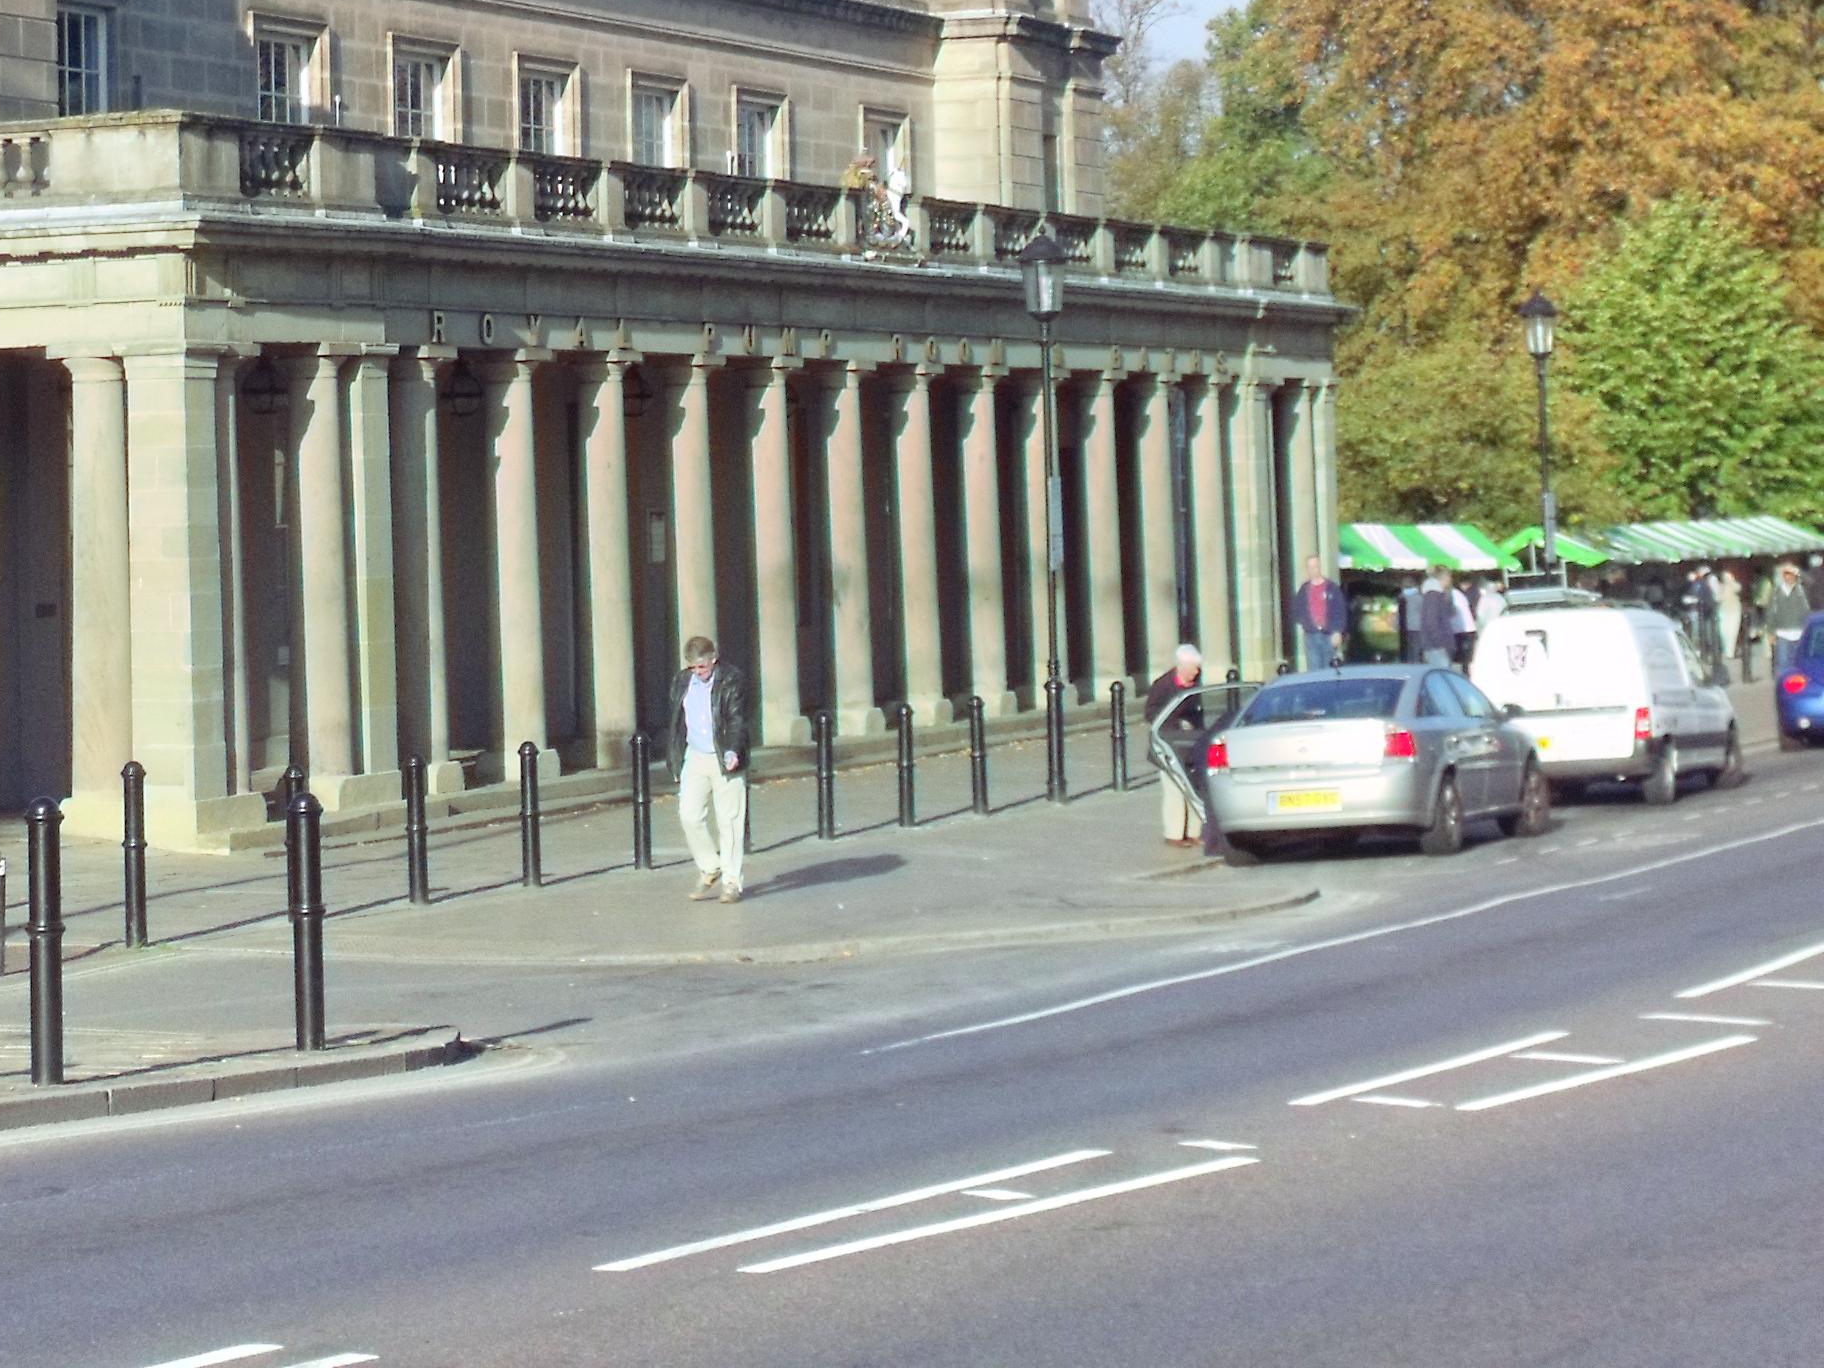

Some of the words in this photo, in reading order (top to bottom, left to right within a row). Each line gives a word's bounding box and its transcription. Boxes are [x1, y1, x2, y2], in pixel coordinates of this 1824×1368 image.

[430, 310, 626, 349] ROYAL
[703, 321, 831, 359] PUMP
[890, 333, 1003, 365] ROOM
